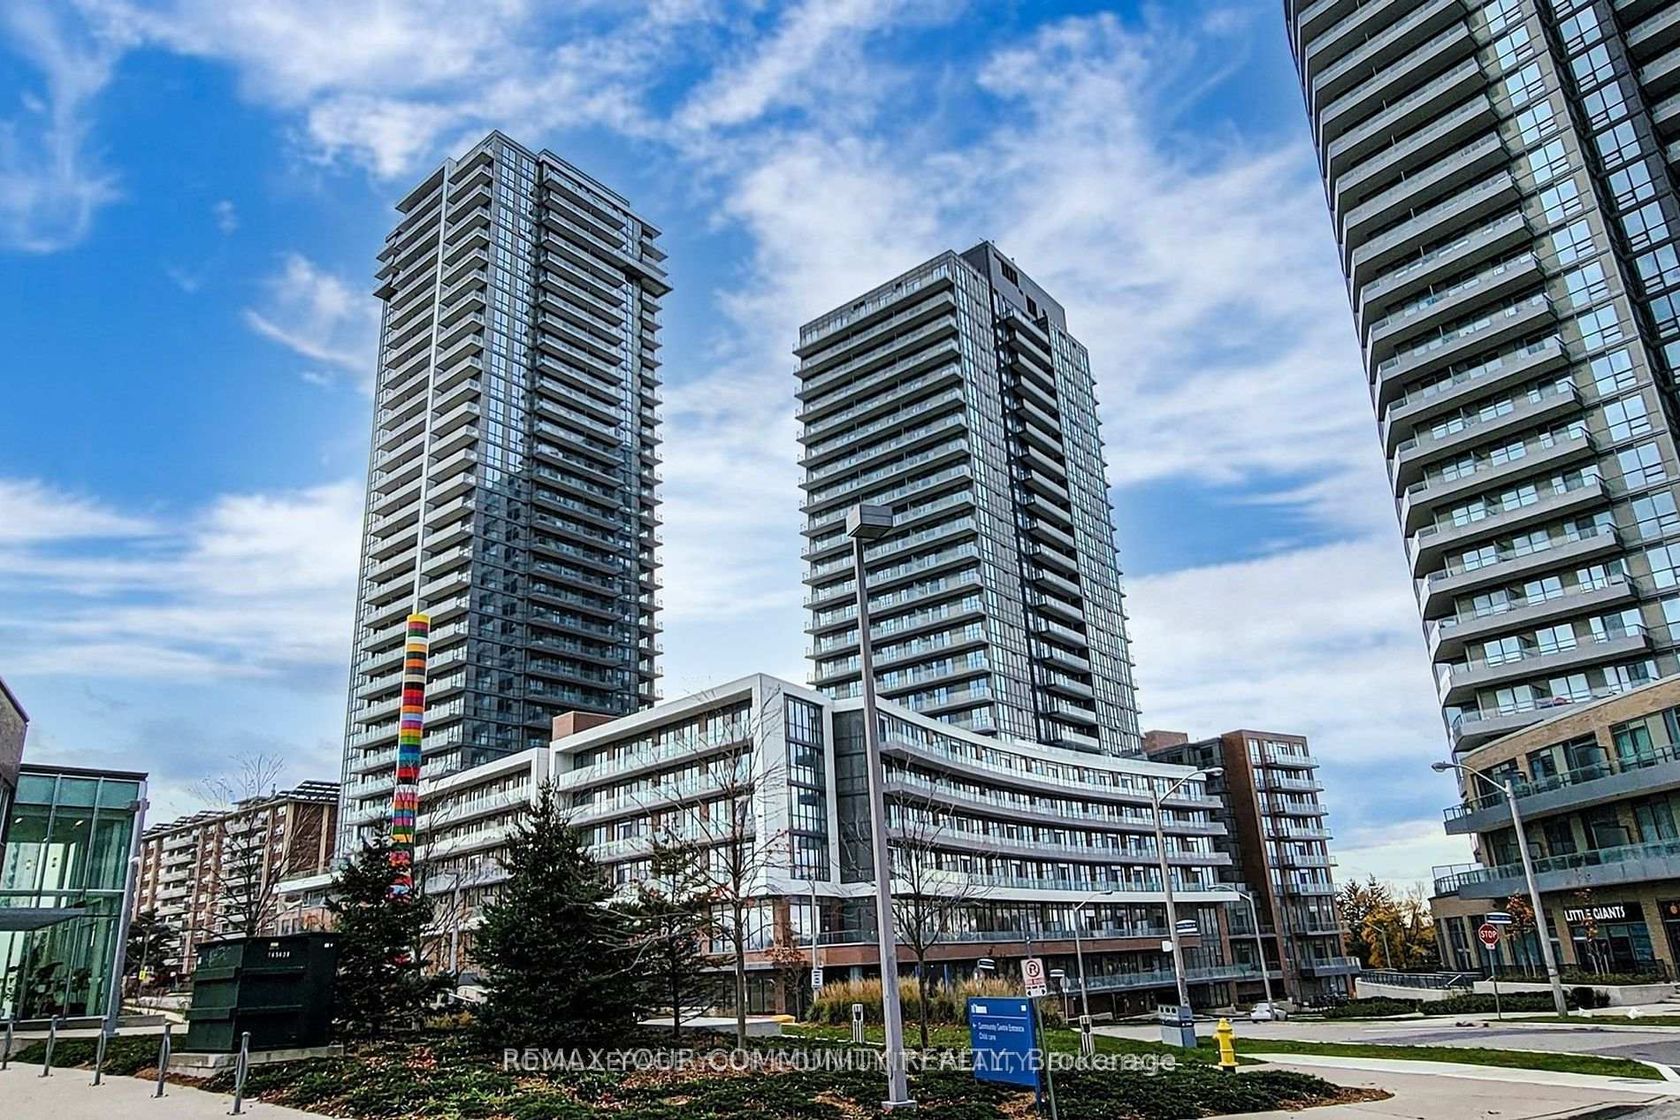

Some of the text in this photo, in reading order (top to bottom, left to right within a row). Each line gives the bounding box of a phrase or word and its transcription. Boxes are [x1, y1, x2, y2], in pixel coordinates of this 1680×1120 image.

[1564, 906, 1625, 922] LITTLE GIANTS
[1480, 930, 1497, 939] STOP
